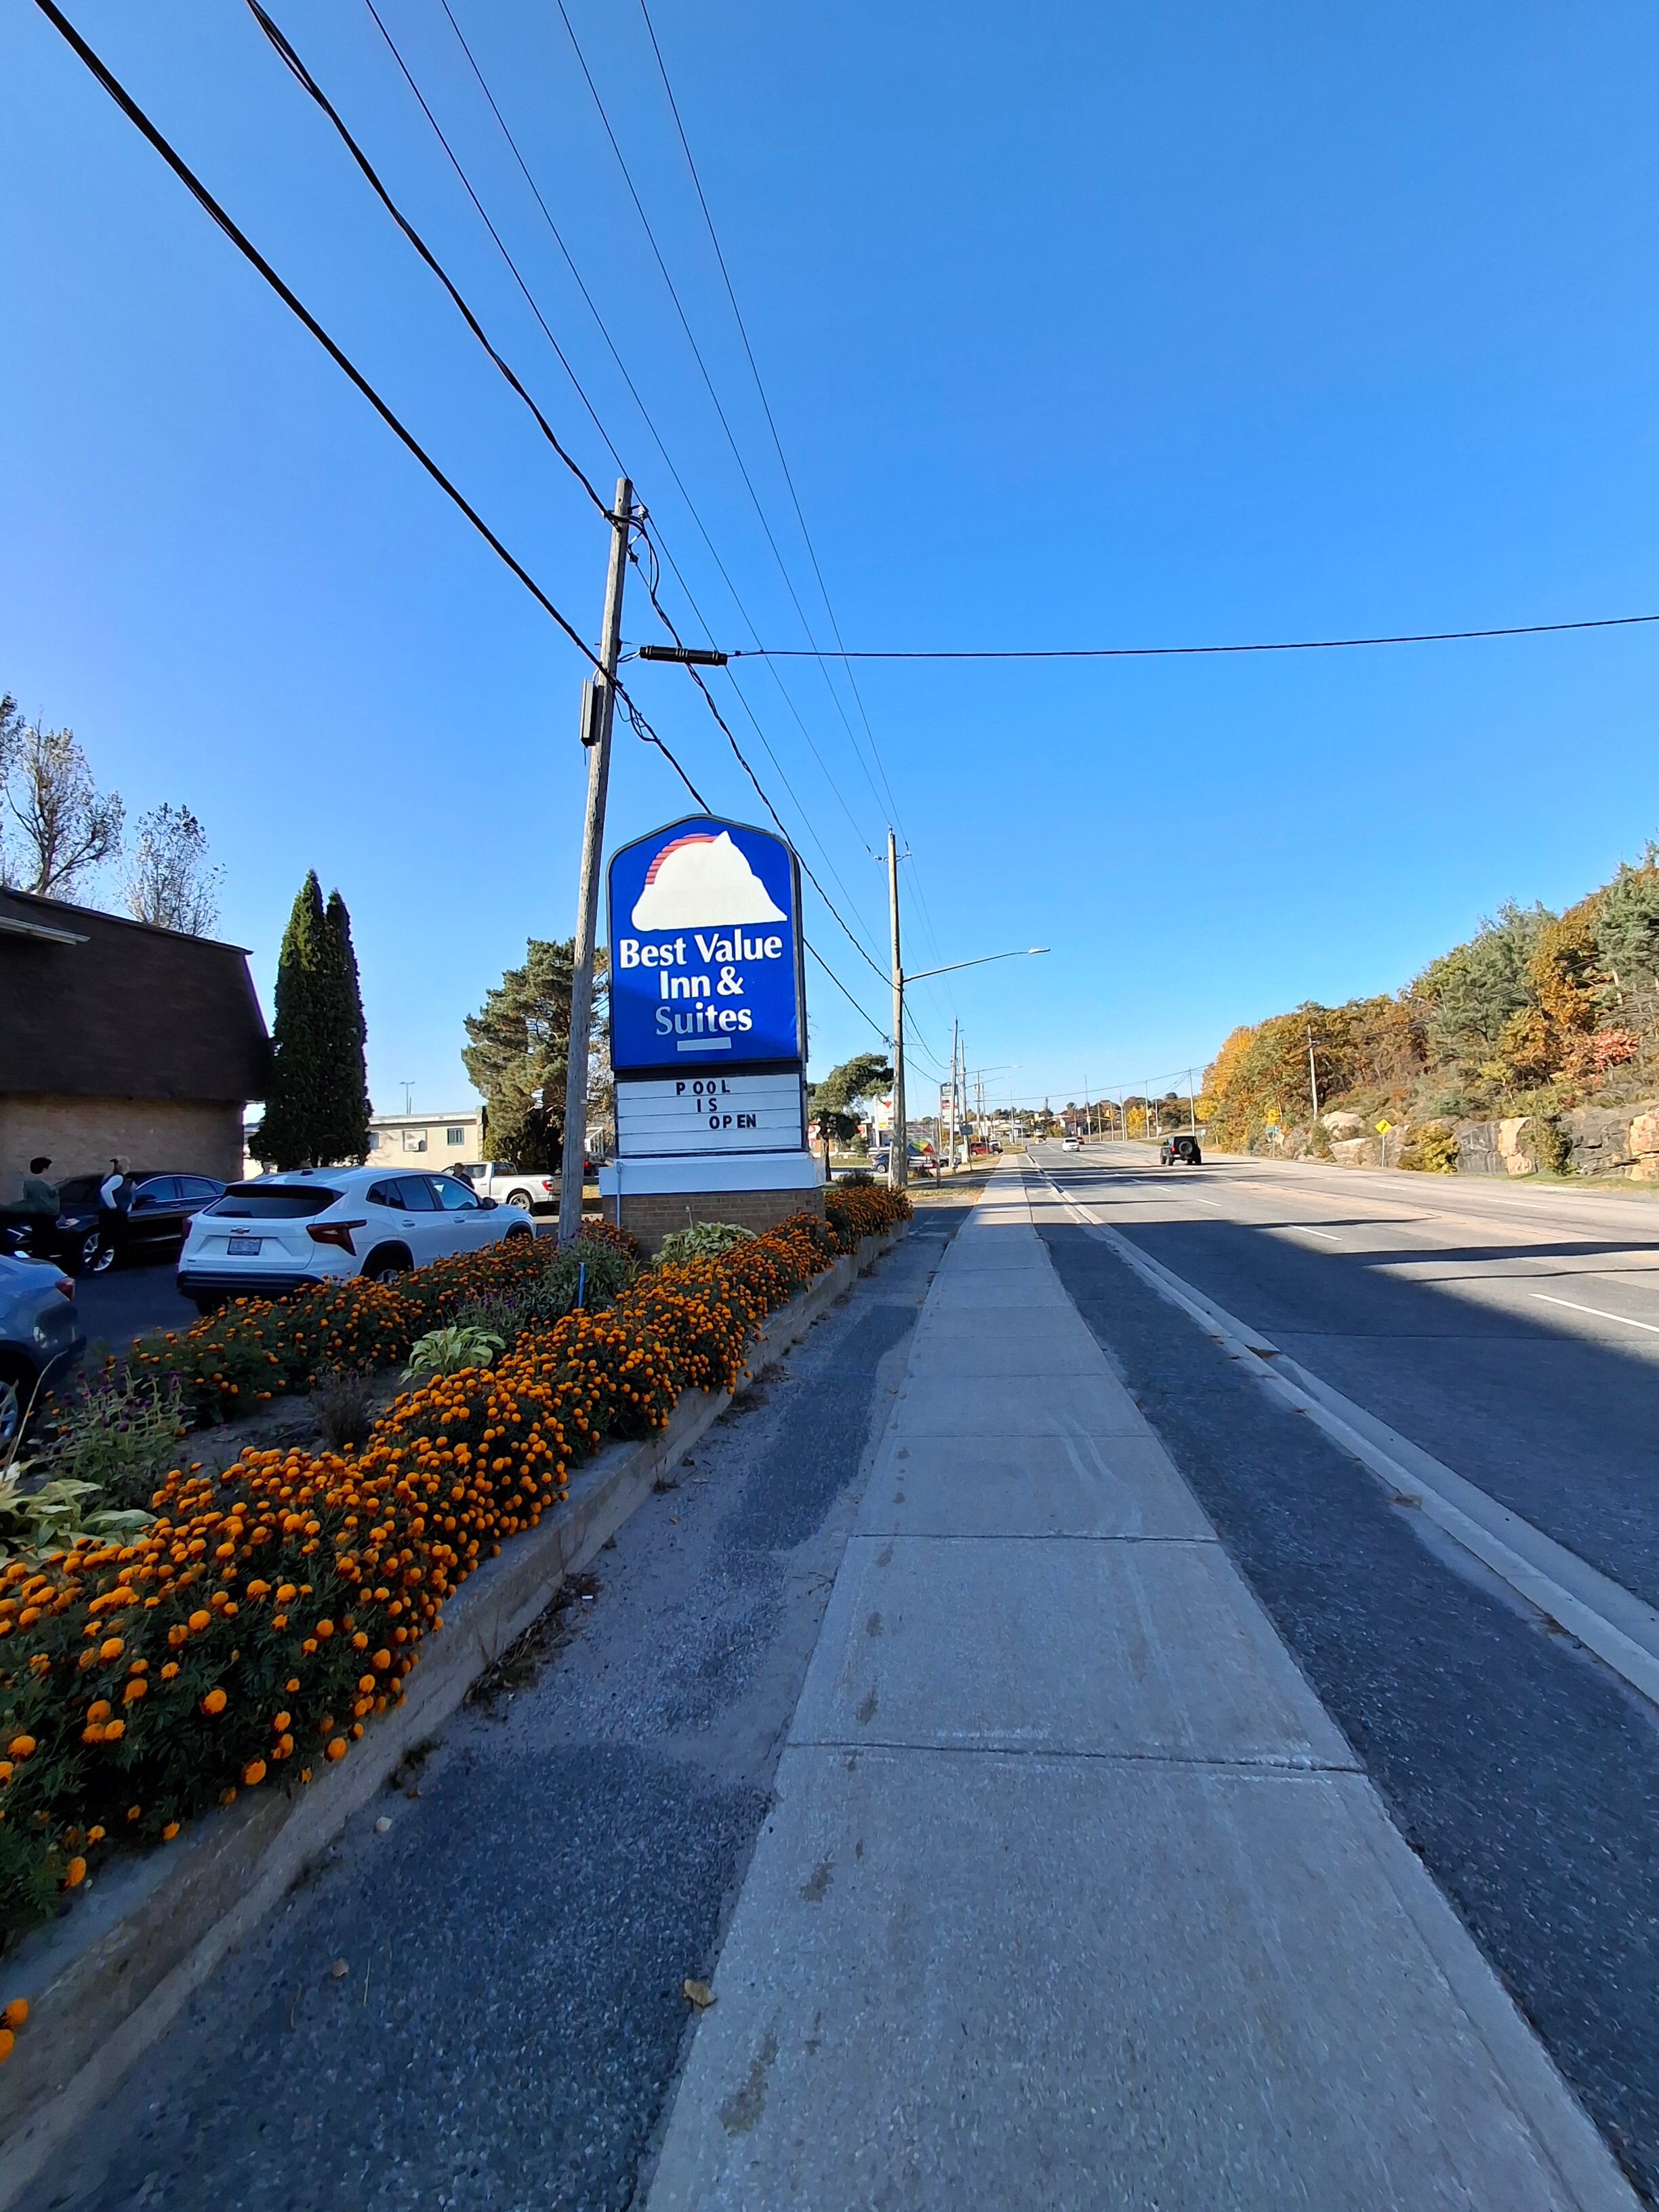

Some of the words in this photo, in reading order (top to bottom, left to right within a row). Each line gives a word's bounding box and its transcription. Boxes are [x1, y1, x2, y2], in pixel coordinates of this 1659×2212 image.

[619, 937, 687, 968] Best
[694, 928, 783, 963] Value
[660, 970, 710, 1000] Inn
[716, 966, 744, 996] &
[655, 1002, 752, 1035] Suites
[676, 1080, 731, 1095] POOL
[697, 1098, 717, 1112] IS
[709, 1113, 756, 1129] OPEN
